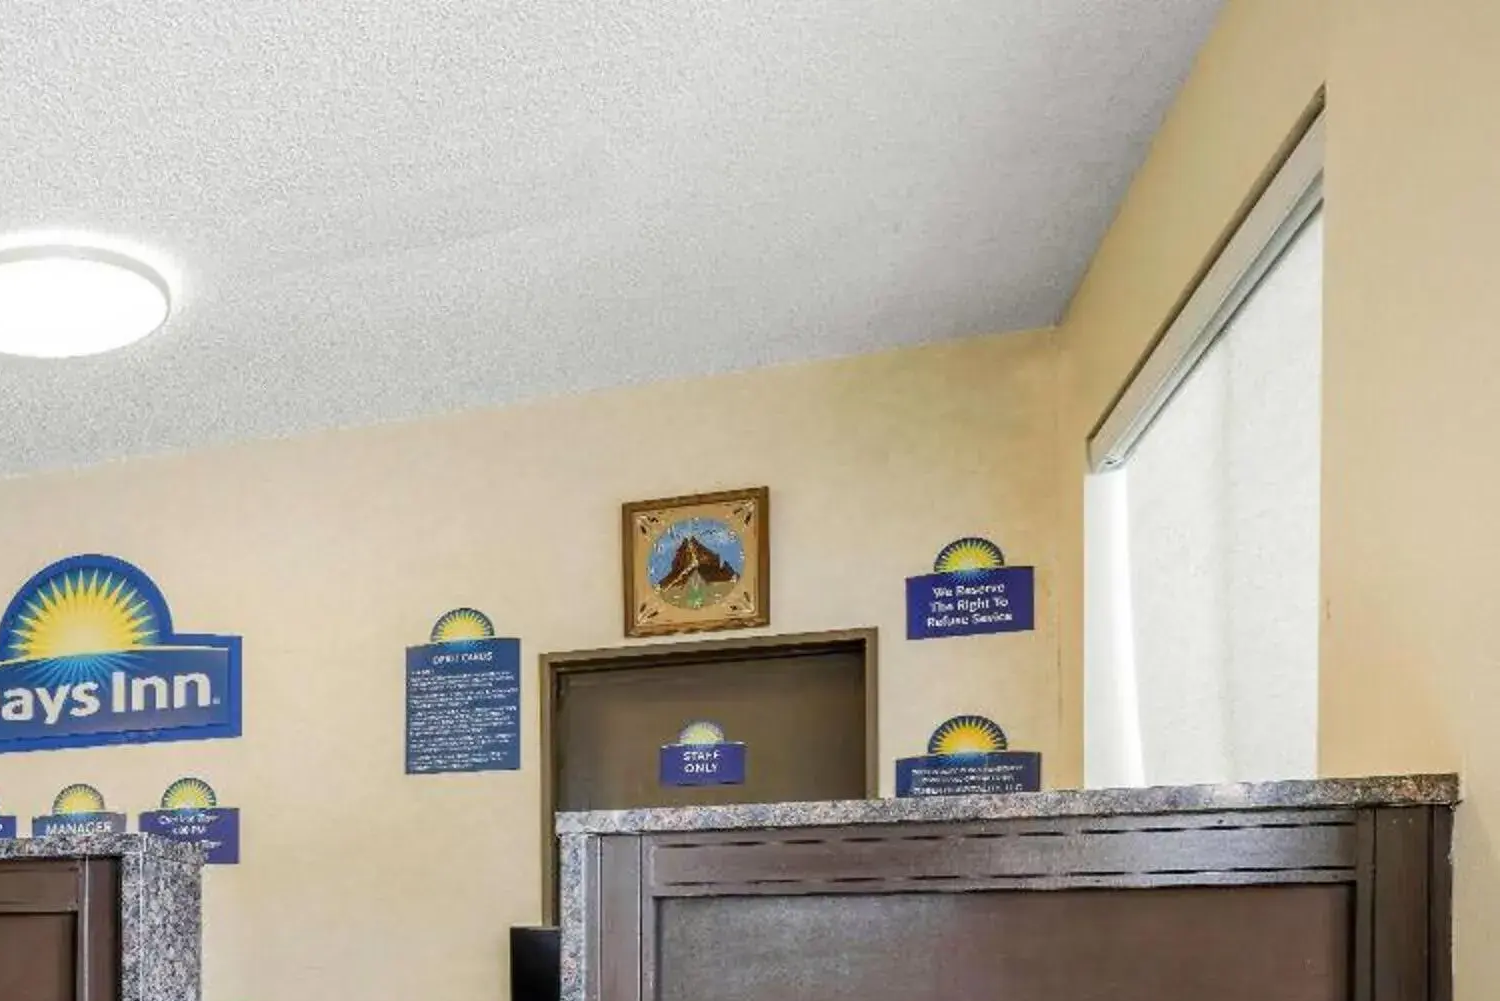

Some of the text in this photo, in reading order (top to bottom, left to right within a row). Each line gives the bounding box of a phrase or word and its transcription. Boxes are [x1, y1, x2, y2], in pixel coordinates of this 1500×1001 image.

[932, 583, 1005, 598] We Reserve
[930, 597, 1009, 613] The Right To
[927, 616, 969, 628] Refuse
[111, 671, 211, 713] Inn
[683, 750, 721, 761] STAFF
[684, 763, 718, 773] ONLY
